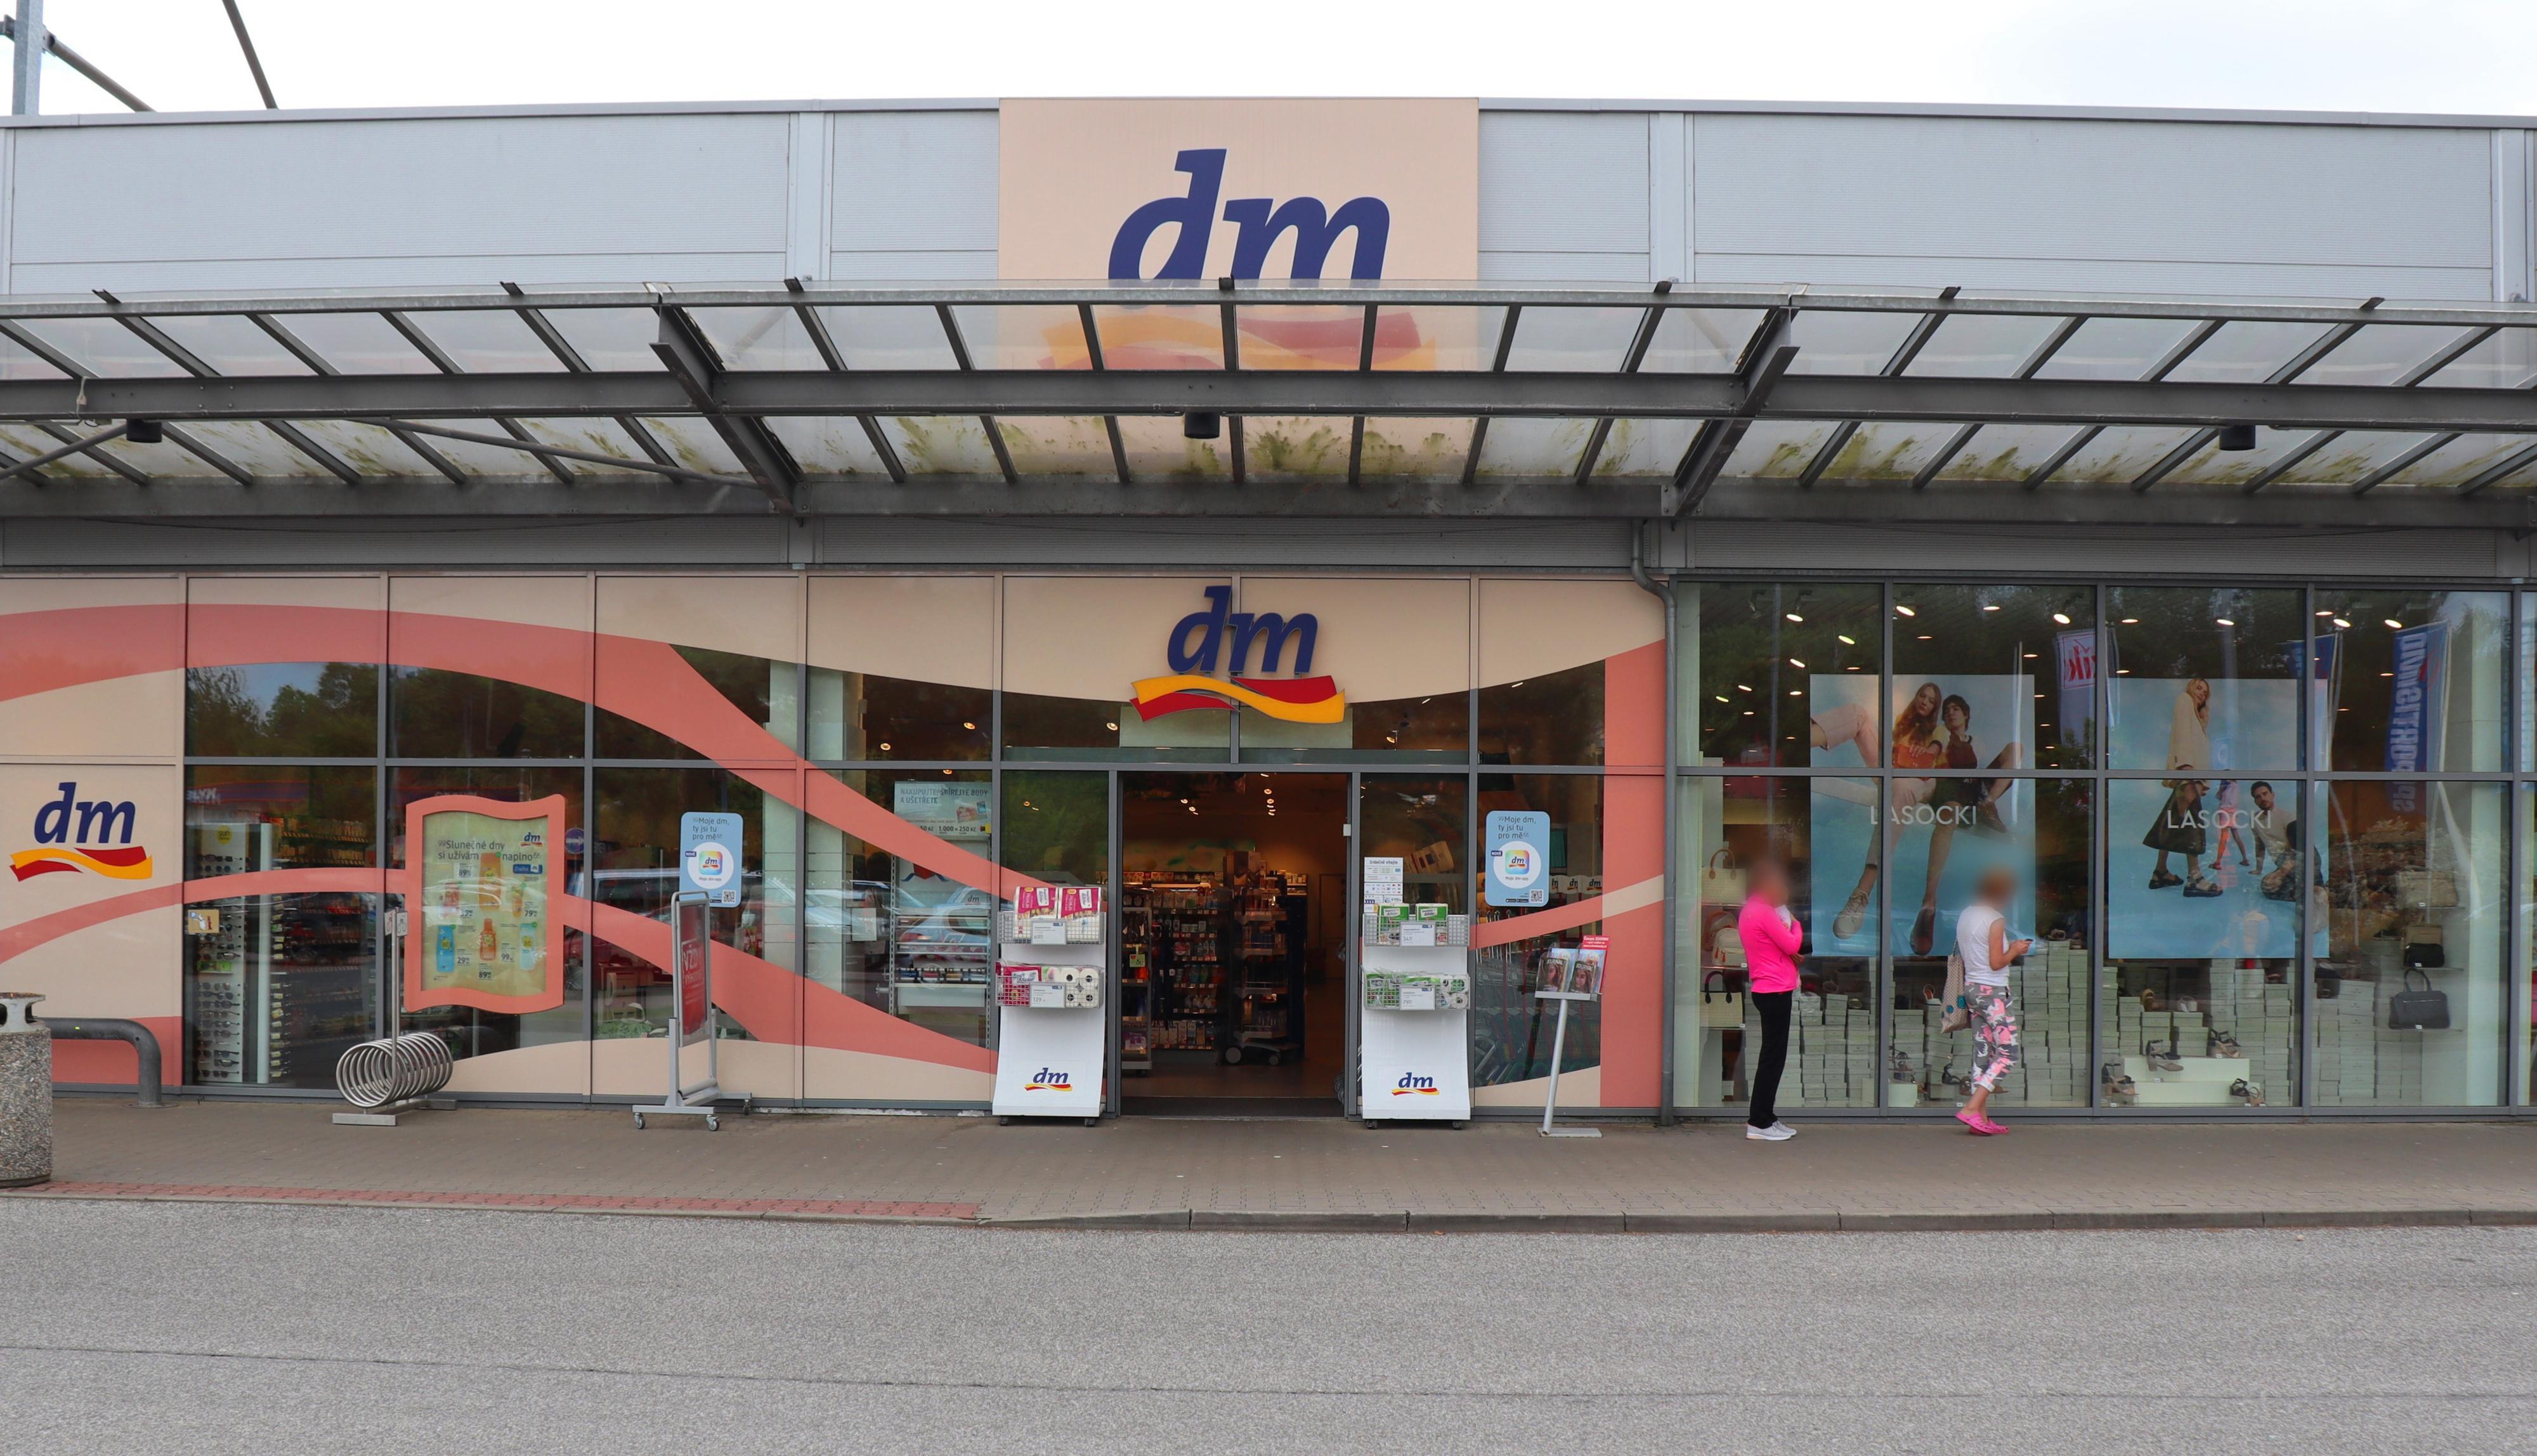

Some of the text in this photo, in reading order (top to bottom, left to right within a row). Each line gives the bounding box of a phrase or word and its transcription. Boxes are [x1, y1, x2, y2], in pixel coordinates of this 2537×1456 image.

[1108, 148, 1390, 307] dm
[1168, 585, 1318, 673] dm
[34, 782, 135, 843] dm
[1870, 805, 1976, 825] LASOCKI
[2167, 810, 2271, 829] LASOCKI
[489, 841, 505, 850] dny
[524, 832, 540, 842] dm
[448, 851, 479, 860] užívám
[1033, 1067, 1069, 1083] dm
[1398, 1072, 1433, 1088] dm
